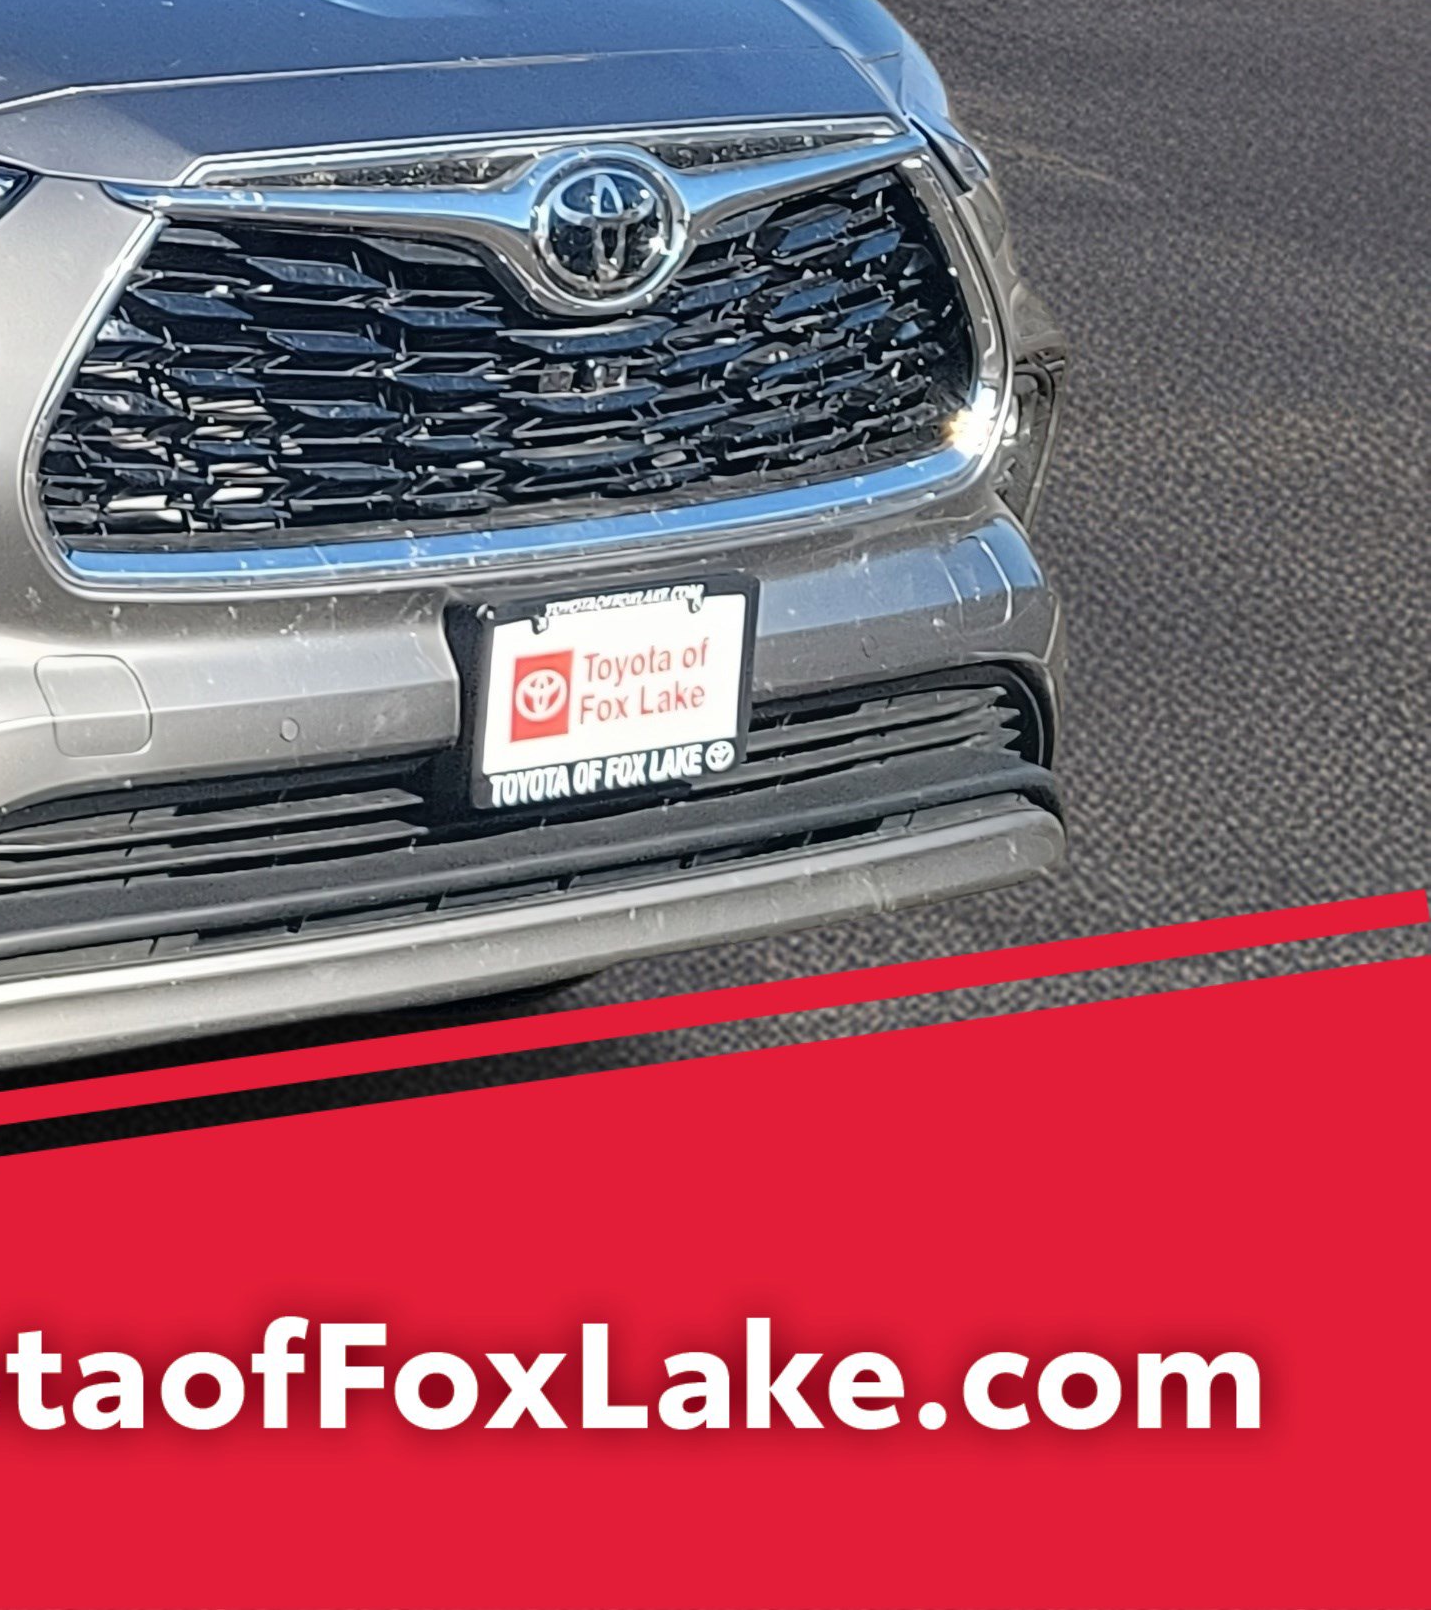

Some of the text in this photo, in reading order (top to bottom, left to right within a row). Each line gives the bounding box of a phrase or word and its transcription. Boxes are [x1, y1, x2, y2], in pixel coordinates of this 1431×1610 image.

[583, 637, 709, 687] Toyota of
[579, 680, 705, 725] Fox Lake
[489, 743, 703, 807] TOYOTA OF FOX LAKE
